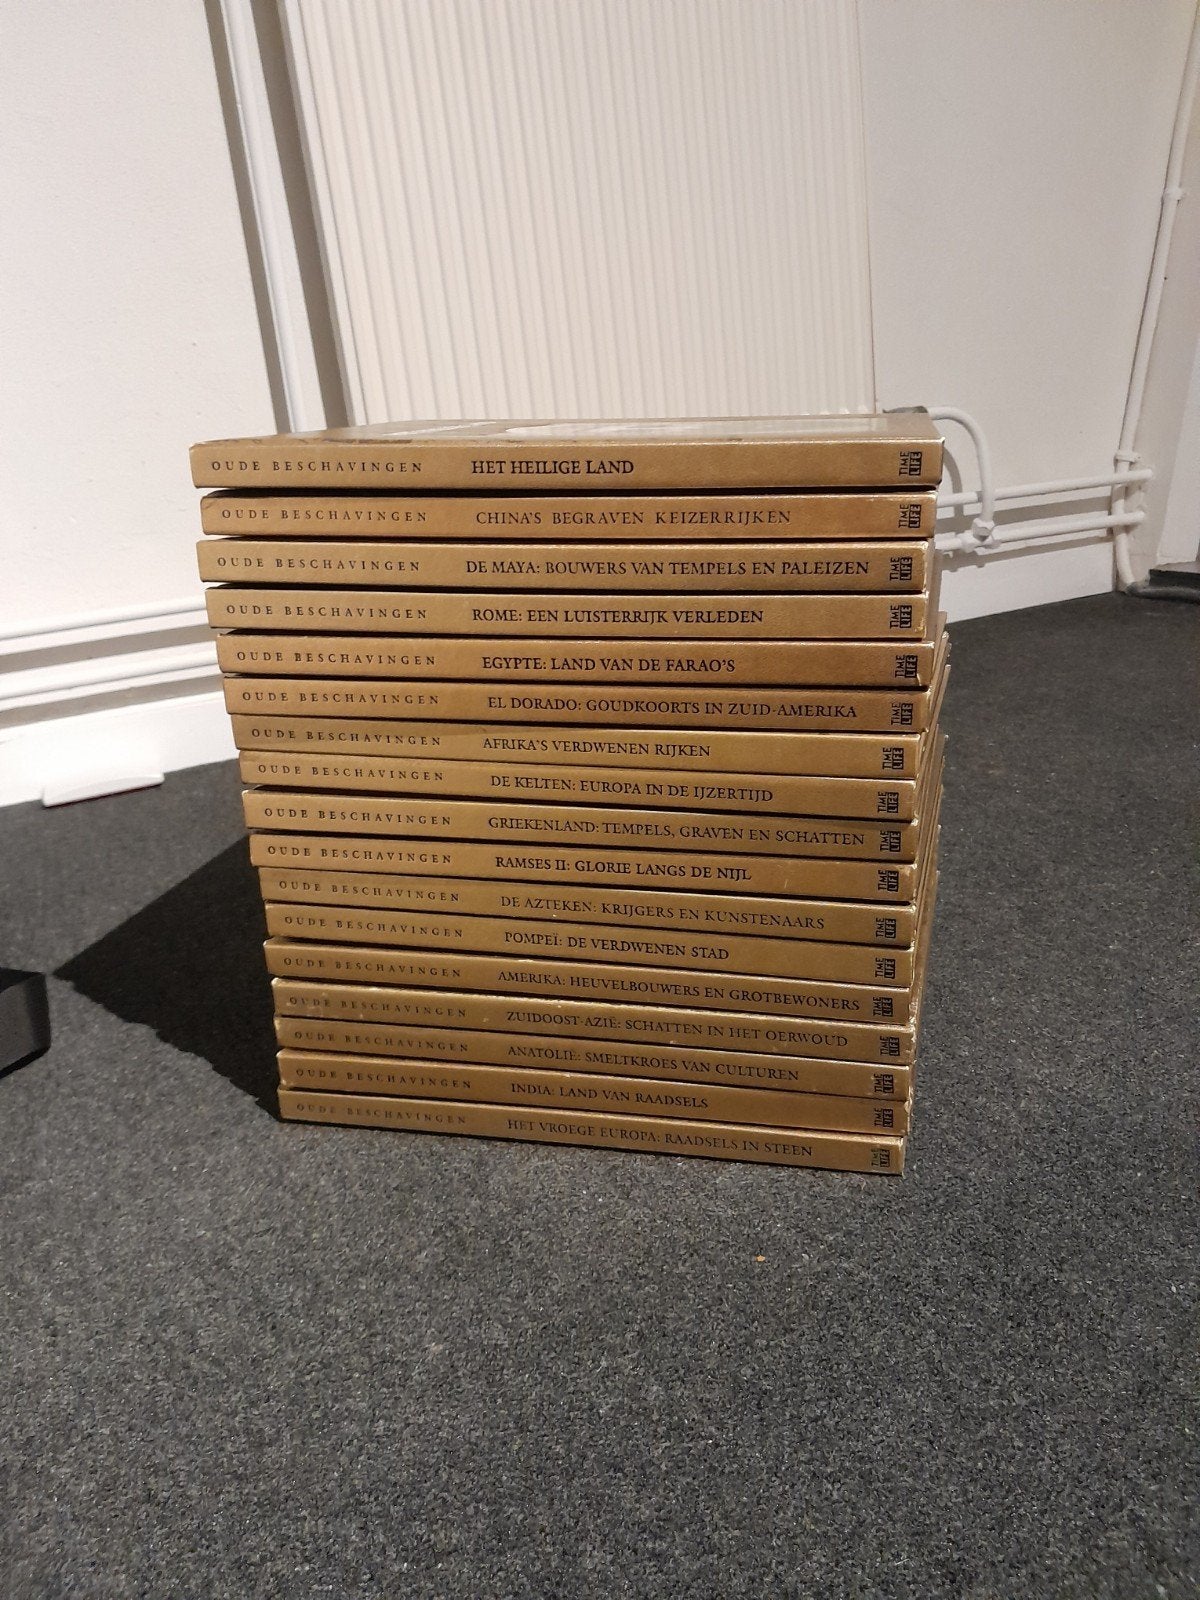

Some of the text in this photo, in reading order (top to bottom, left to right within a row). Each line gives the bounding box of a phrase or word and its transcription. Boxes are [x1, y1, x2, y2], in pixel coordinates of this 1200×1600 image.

[211, 461, 421, 472] OUDE BESCHAVINGEN
[471, 460, 634, 474] HET HEILIGE LAND
[899, 452, 909, 476] TIME
[909, 451, 922, 476] LIFE
[221, 509, 426, 521] OUDE BESCHAVINGEN
[552, 511, 644, 524] BEGRAVEN
[655, 511, 790, 524] KEIZERRIJKEN
[898, 504, 909, 528] TIME
[909, 504, 921, 528] LIFE
[216, 557, 419, 570] OUDE BESCHAVINGEN
[466, 561, 868, 574] DE MAYA: BOUWERS VAN TEMPELS EN PALEIZEN
[890, 557, 900, 580] TIME
[900, 557, 912, 580] LIFE
[226, 605, 426, 618] OUDE BESCHAVINGEN
[472, 609, 763, 624] ROME: EEN LUISTERRIJK VERLEDEN
[890, 605, 900, 628] TIME
[900, 605, 912, 628] LIFE
[236, 651, 434, 665] OUDE BESCHAVINGEN
[482, 656, 546, 669] EGYPTE:
[550, 657, 596, 670] LAND
[599, 658, 633, 670] VAN
[638, 658, 660, 671] DE
[895, 655, 905, 678] TIME
[905, 655, 918, 678] LIFE
[242, 691, 438, 704] OUDE BESCHAVINGEN
[488, 697, 856, 717] EL DORADO: GOUDKOORTS IN ZUID-AMERIKA
[891, 702, 901, 725] TIME
[901, 703, 913, 726] LIFE
[251, 728, 440, 745] OUDE BESCHAVINGEN
[551, 741, 648, 754] VERDWENEN
[654, 744, 710, 757] RIJKEN
[882, 748, 892, 769] TIME
[892, 748, 904, 770] LIFE
[258, 764, 442, 780] OUDE BESCHAVINGEN
[490, 775, 773, 801] DE KELTEN: EUROPA IN DE IJZERTIJD
[878, 792, 888, 812] TIME
[887, 792, 899, 813] LIFE
[264, 808, 450, 824] OUDE BESCHAVINGEN
[488, 817, 864, 845] GRIEKENLAND: TEMPELS, GRAVEN EN SCHATTEN
[880, 830, 890, 851] TIME
[890, 831, 900, 852] LIFE
[267, 845, 450, 863] OUDE BESCHAVINGEN
[495, 856, 752, 881] RAMSES II: GLORIE LANGS DE NIJL
[878, 870, 888, 890] TIME
[887, 870, 899, 892] LIFE
[278, 880, 459, 901] OUDE BESCHAVINGEN
[501, 896, 824, 929] DE AZTEKEN: KRIJGERS EN KUNSTENAARS
[284, 916, 462, 937] OUDE BESCHAVINGEN
[876, 917, 885, 938] TIME
[885, 918, 896, 938] LIFE
[567, 936, 587, 948] DE
[590, 939, 686, 955] VERDWENEN
[690, 946, 729, 959] STAD
[283, 957, 460, 977] OUDE BESCHAVINGEN
[875, 958, 884, 978] TIME
[884, 958, 895, 979] LIFE
[498, 971, 860, 1010] AMERIKA: HEUVELBOUWERS EN GROTBEWONERS
[288, 997, 466, 1017] OUDE BESCHAVINGEN
[873, 997, 882, 1016] TIME
[882, 998, 892, 1016] LIFE
[294, 1031, 468, 1051] OUDE BESCHAVINGEN
[625, 1019, 702, 1034] SCHATTEN
[706, 1025, 724, 1036] IN
[728, 1027, 761, 1039] HET
[765, 1030, 848, 1046] OERWOUD
[880, 1036, 889, 1054] TIME
[889, 1037, 900, 1056] LIFE
[584, 1052, 678, 1069] SMELTKROES
[681, 1060, 710, 1072] VAN
[715, 1064, 798, 1080] CULTUREN
[296, 1068, 470, 1088] OUDE BESCHAVINGEN
[874, 1074, 883, 1092] TIME
[883, 1074, 893, 1094] LIFE
[560, 1086, 598, 1098] LAND
[602, 1090, 630, 1101] VAN
[635, 1093, 708, 1108] RAADSELS
[296, 1102, 466, 1124] OUDE BESCHAVINGEN
[874, 1108, 883, 1126] TIME
[883, 1109, 893, 1128] LIFE
[508, 1119, 813, 1156] HET VROEGE EUROPA: RAADSELS IN STEEN
